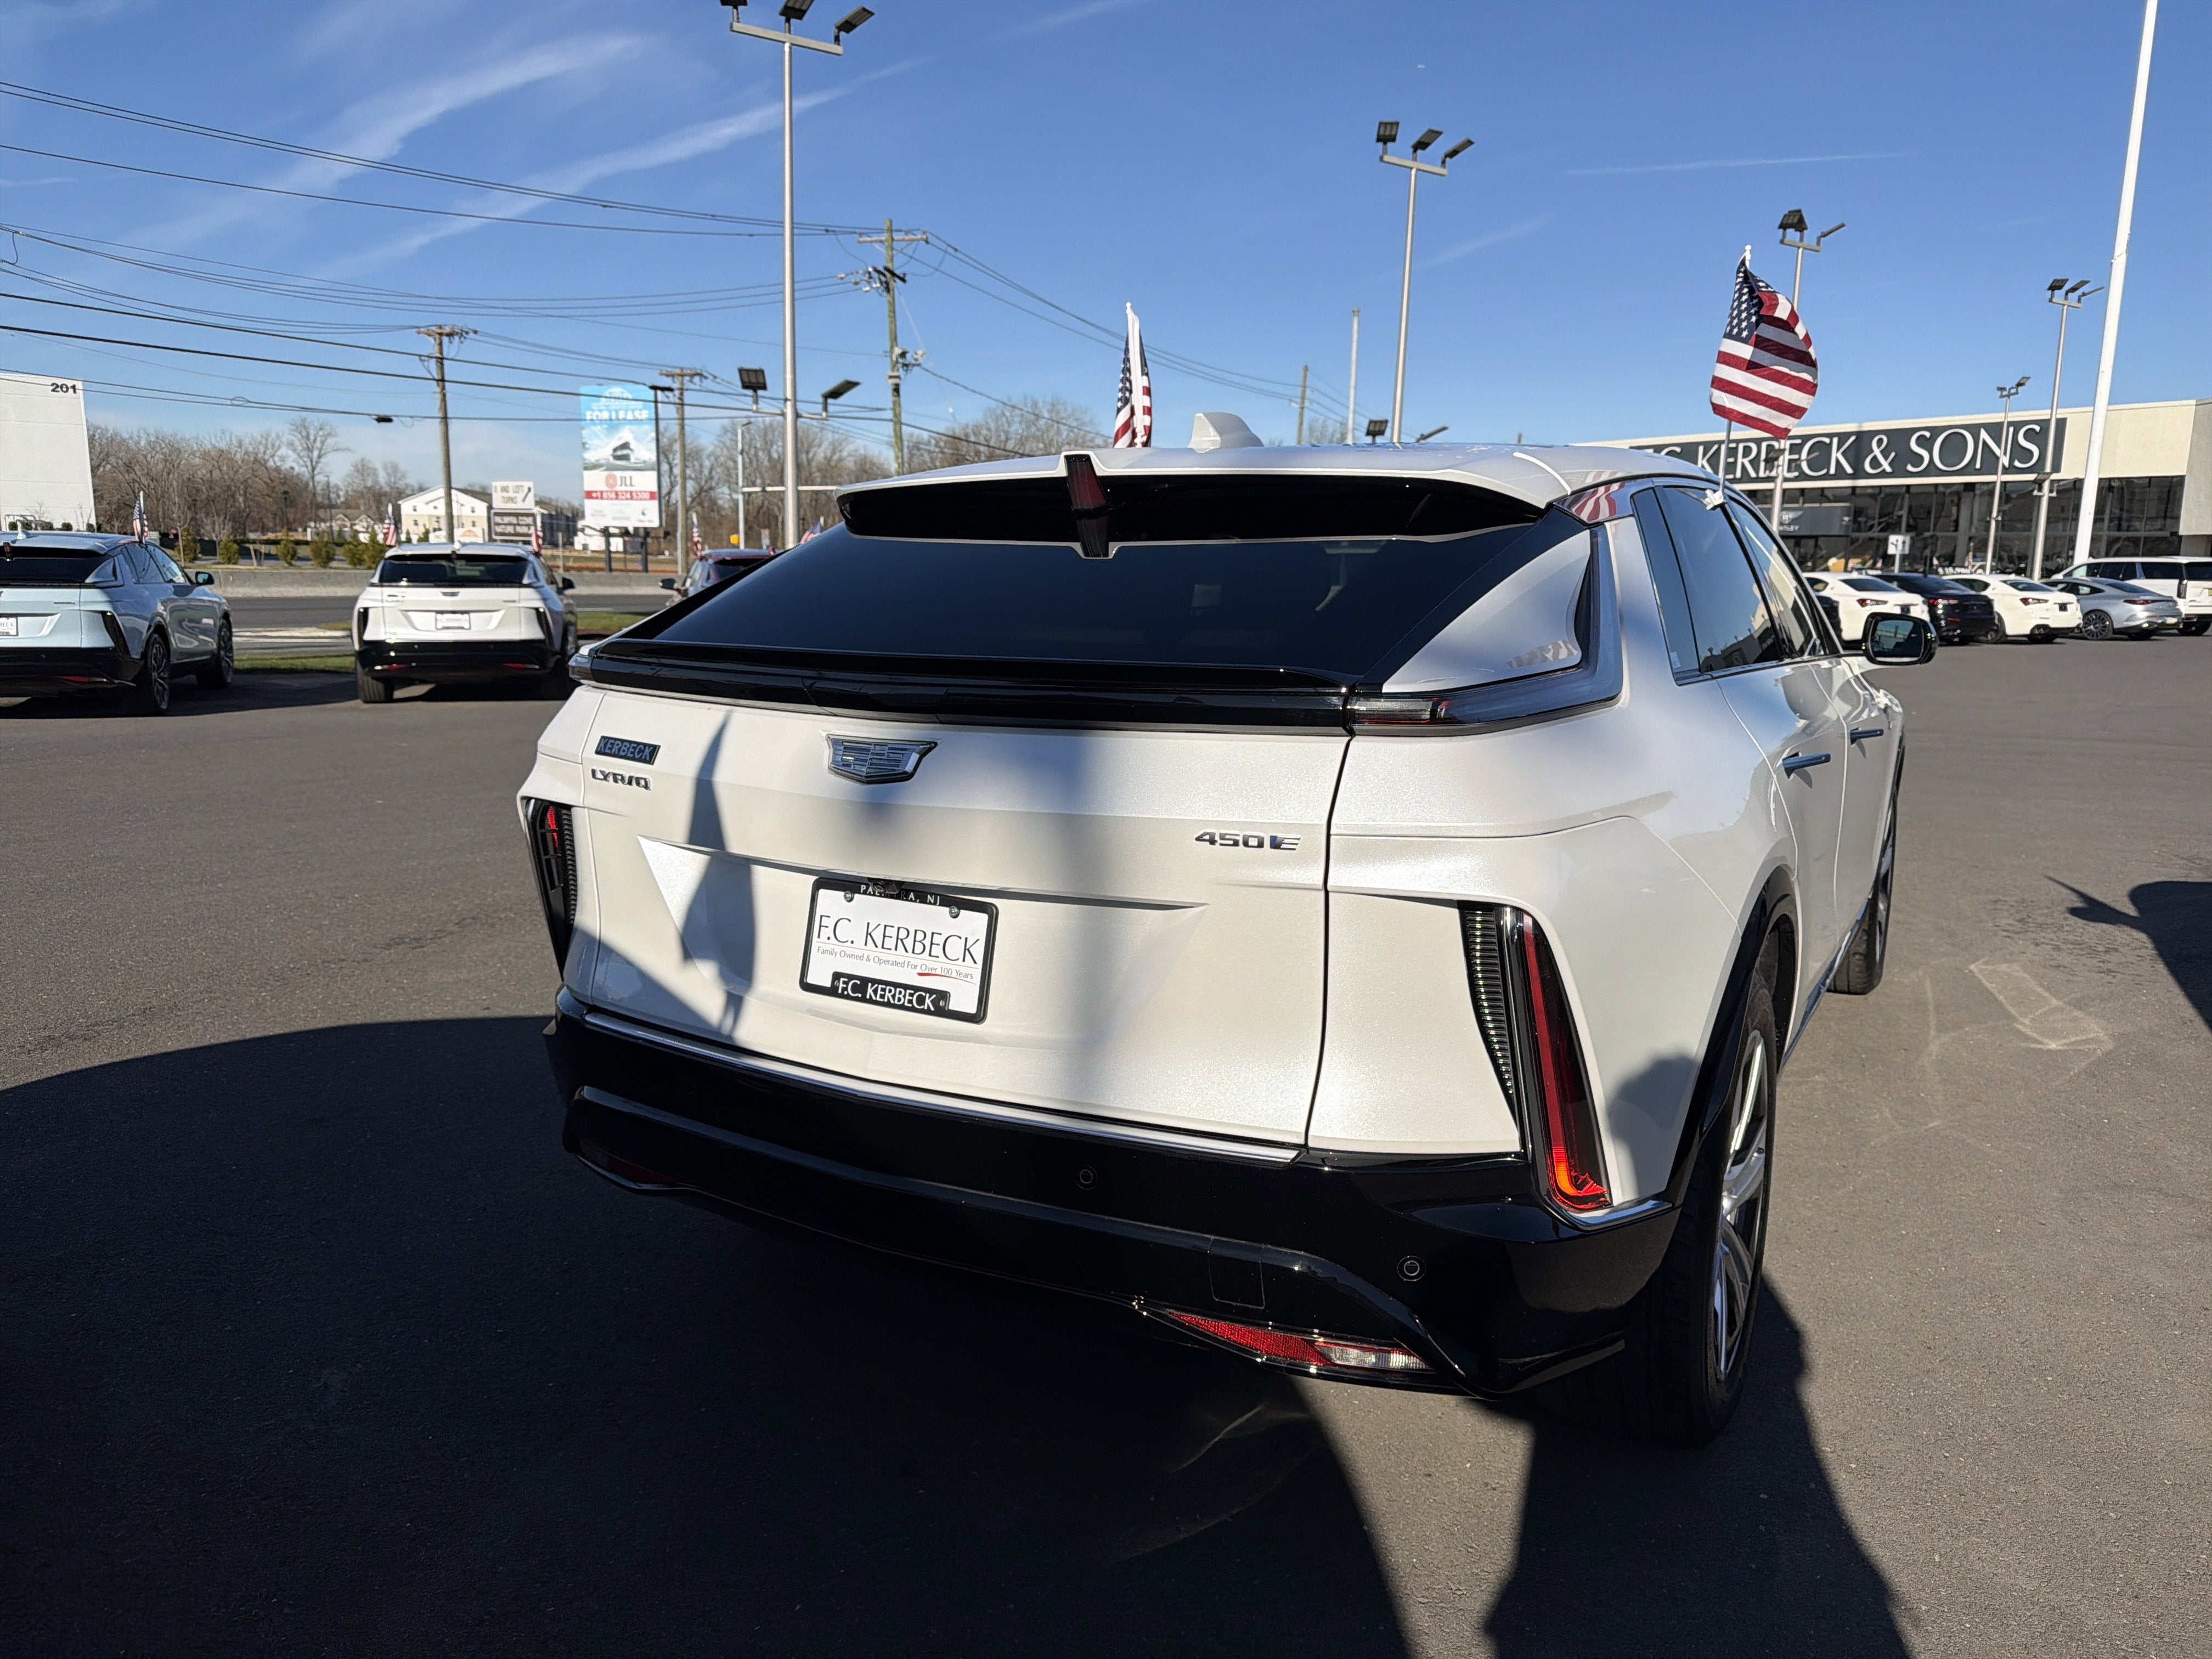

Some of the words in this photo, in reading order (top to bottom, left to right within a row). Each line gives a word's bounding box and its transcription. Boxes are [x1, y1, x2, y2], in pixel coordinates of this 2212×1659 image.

[50, 383, 77, 394] 201
[586, 410, 610, 422] FOR
[1864, 435, 1896, 474] &
[1906, 424, 2041, 472] SONS
[619, 475, 636, 487] JLL
[597, 738, 653, 760] KERBECK
[591, 768, 652, 791] LYRIQ
[927, 895, 940, 906] NJ
[817, 914, 854, 945] F.C.
[864, 922, 980, 964] KERBECK
[817, 946, 838, 958] Family
[839, 950, 864, 961] Owned
[873, 956, 905, 968] Operated
[906, 962, 918, 970] For
[920, 964, 938, 973] Over
[940, 966, 953, 975] 100
[955, 969, 973, 980] Years
[838, 978, 862, 997] F.C.
[866, 983, 937, 1011] KERBECK
